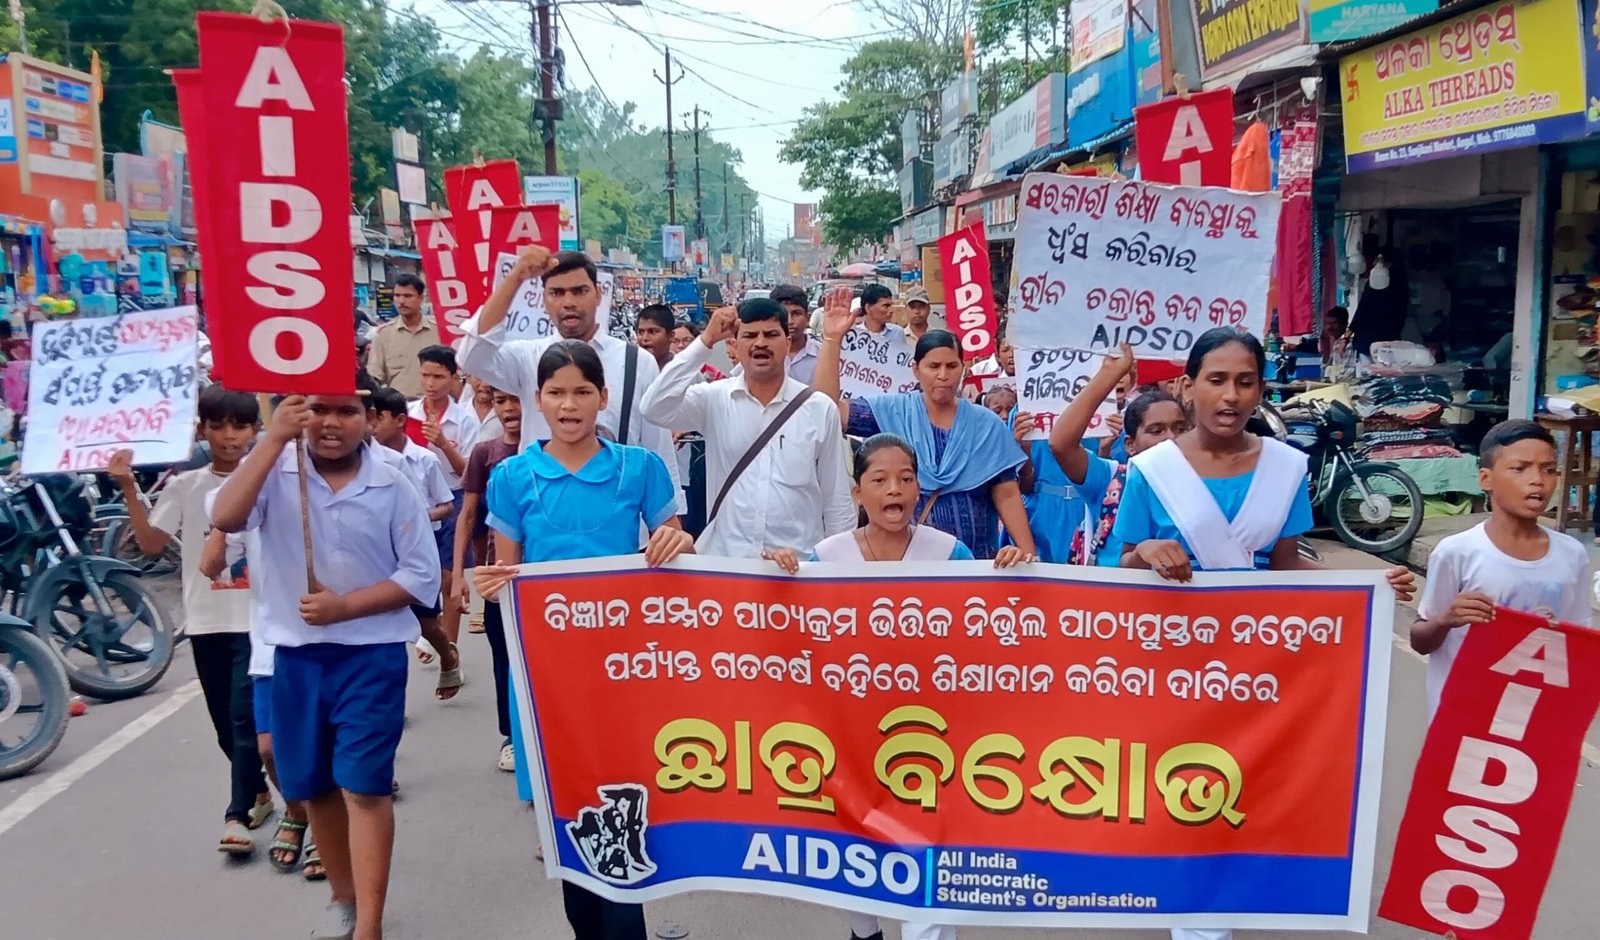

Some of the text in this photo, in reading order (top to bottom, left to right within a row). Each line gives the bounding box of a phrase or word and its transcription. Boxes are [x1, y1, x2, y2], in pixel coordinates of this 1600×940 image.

[1384, 86, 1424, 119] ALKA
[1430, 63, 1514, 107] THREADS
[235, 46, 329, 375] AIDSO
[1025, 182, 1110, 220] ସରକାରୀ
[1105, 231, 1198, 273] କରିବାର
[428, 221, 472, 349] AIDS
[951, 237, 990, 352] AIDSO
[1090, 324, 1193, 351] AIDSO
[544, 592, 1343, 654] ବିଜ୍ଞାନ ସମ୍ମତ ପାଠ୍ୟକ୍ରମ ଭିତ୍ତିକ ନିର୍ଭୁଲ ପାଠ୍ୟପୁସ୍ତକ ନହେବା
[604, 642, 1280, 704] ପର୍ଯ୍ୟନ୍ତ ଗତବର୍ଷ ବହିରେ ଶିକ୍ଷାଦାନ କରିବା ଦାବିରେ
[653, 704, 1247, 828] ଛାତ୍ର ବିକ୍ଷୋଭ
[1420, 627, 1569, 929] AIDSO
[741, 832, 921, 896] AIDSO
[937, 851, 1018, 871] All India
[937, 869, 1049, 891] Democratic
[936, 887, 1158, 910] Student's Organisation
